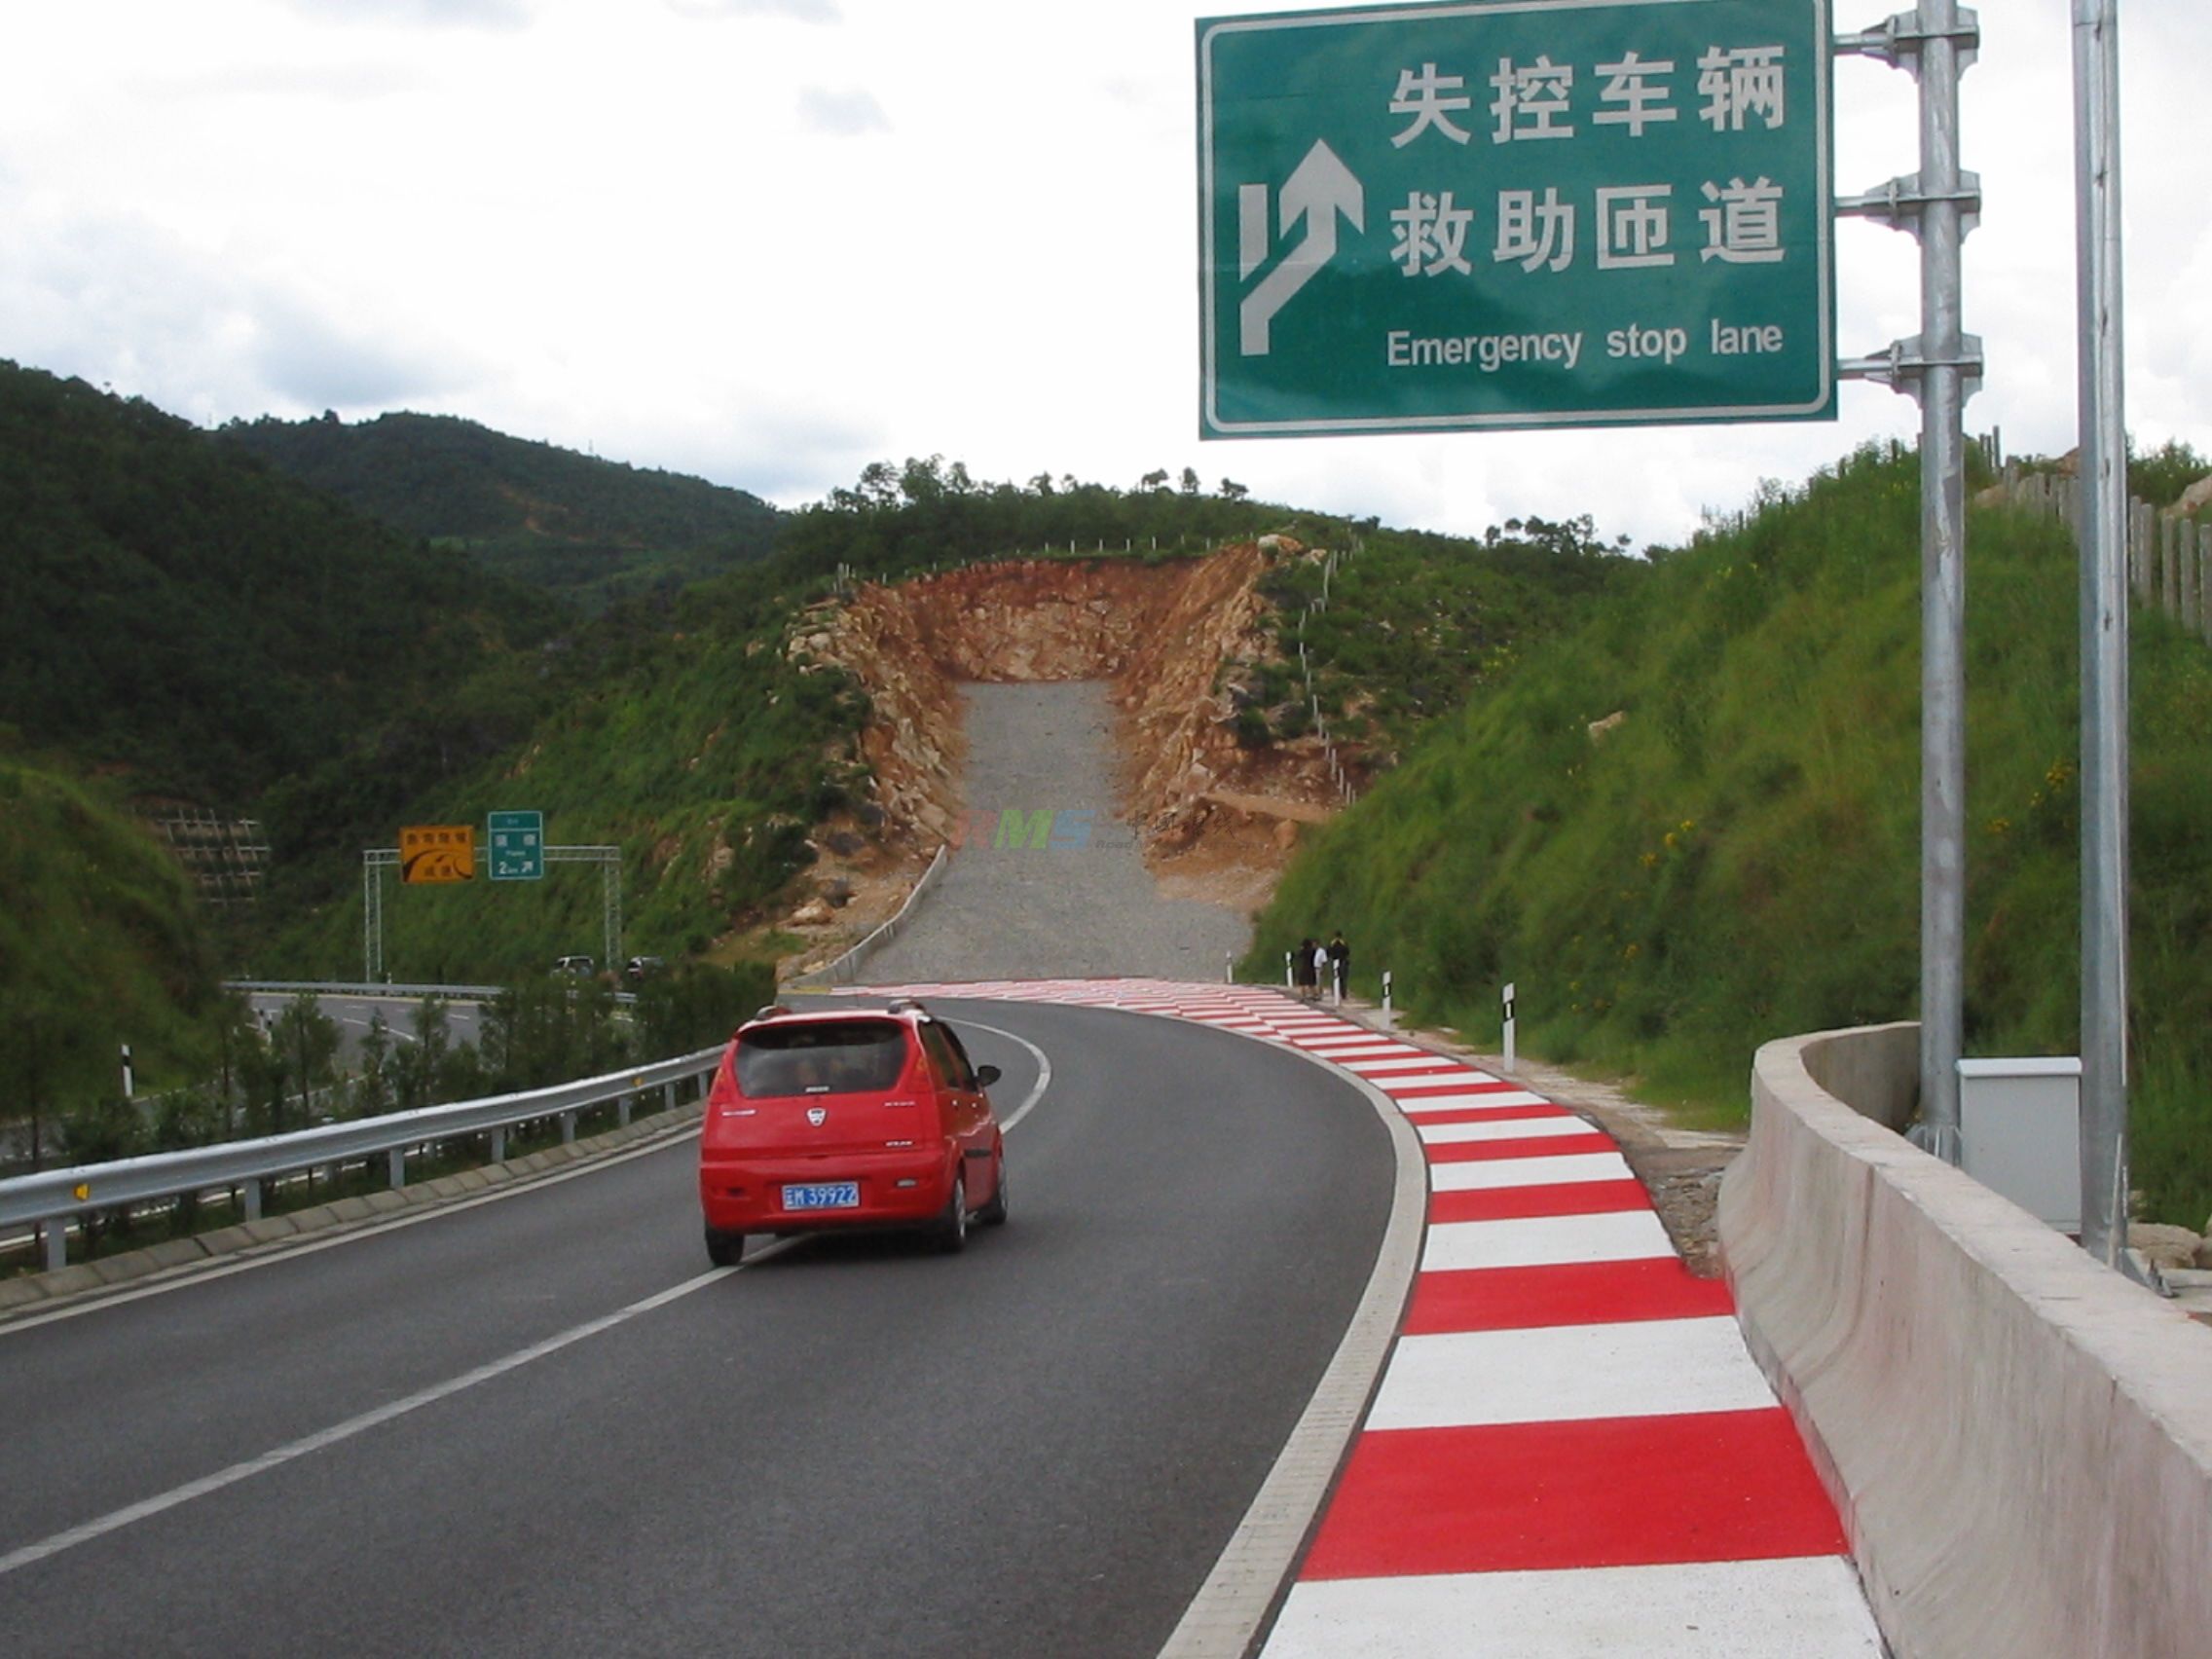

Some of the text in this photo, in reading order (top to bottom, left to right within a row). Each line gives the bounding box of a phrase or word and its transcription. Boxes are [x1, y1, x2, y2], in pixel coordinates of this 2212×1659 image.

[1388, 44, 1786, 148] 失控车辆
[1389, 175, 1786, 276] 救助匝道
[1387, 318, 1784, 372] Emergency stop lane
